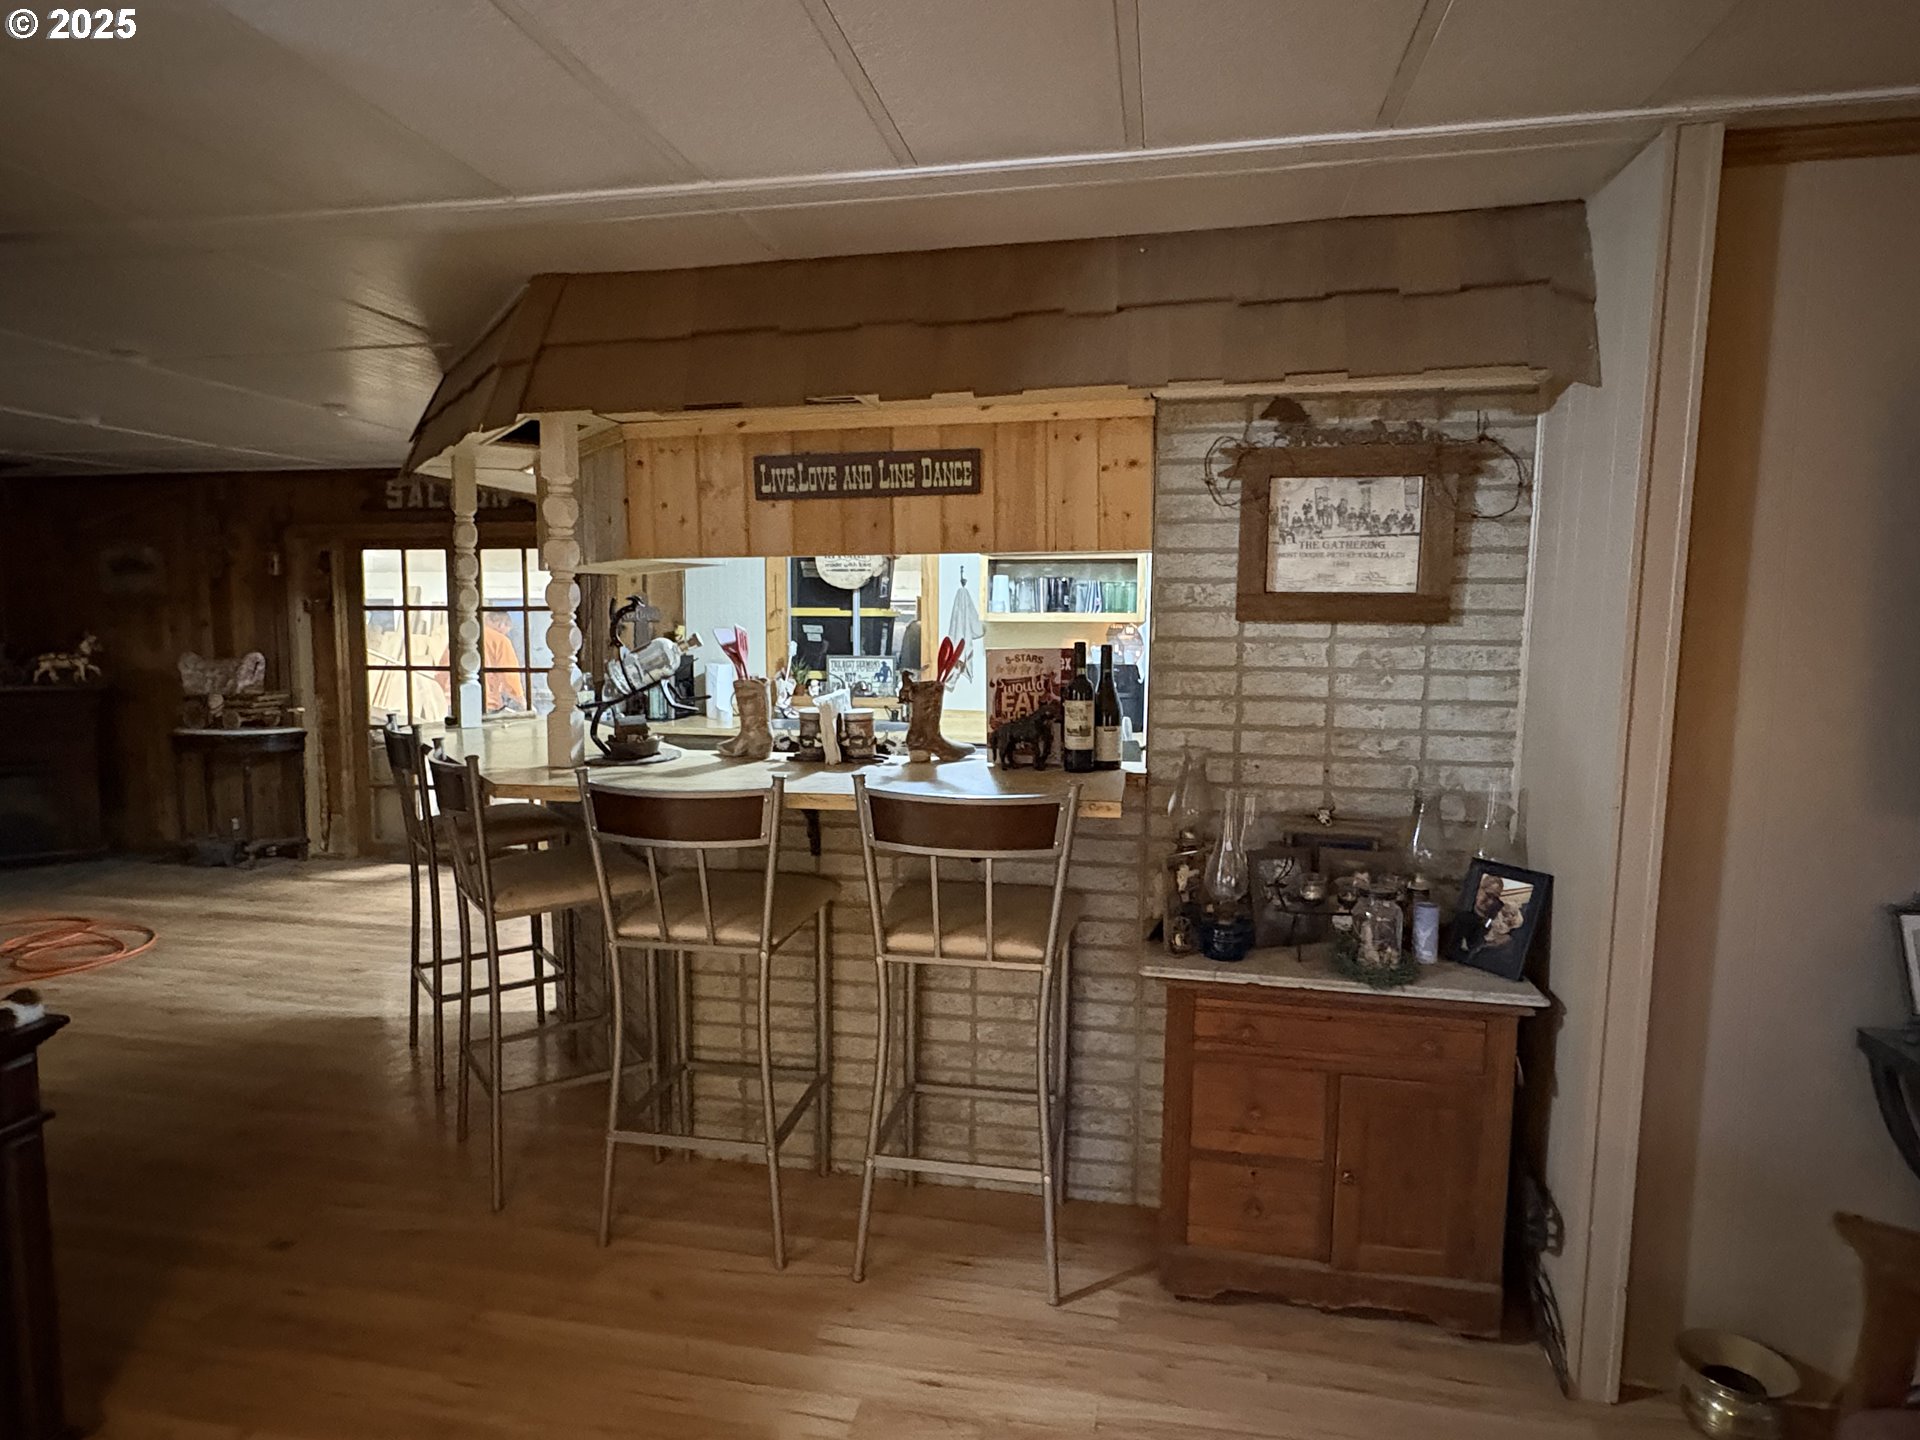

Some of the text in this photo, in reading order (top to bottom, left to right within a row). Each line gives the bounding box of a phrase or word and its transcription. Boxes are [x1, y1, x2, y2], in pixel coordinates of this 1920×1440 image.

[843, 465, 872, 490] AND
[878, 459, 914, 489] LINE
[921, 457, 972, 488] DANCE
[1299, 540, 1385, 550] THE GATHERING
[1005, 654, 1044, 664] 5-STARS
[1001, 690, 1044, 714] EAT
